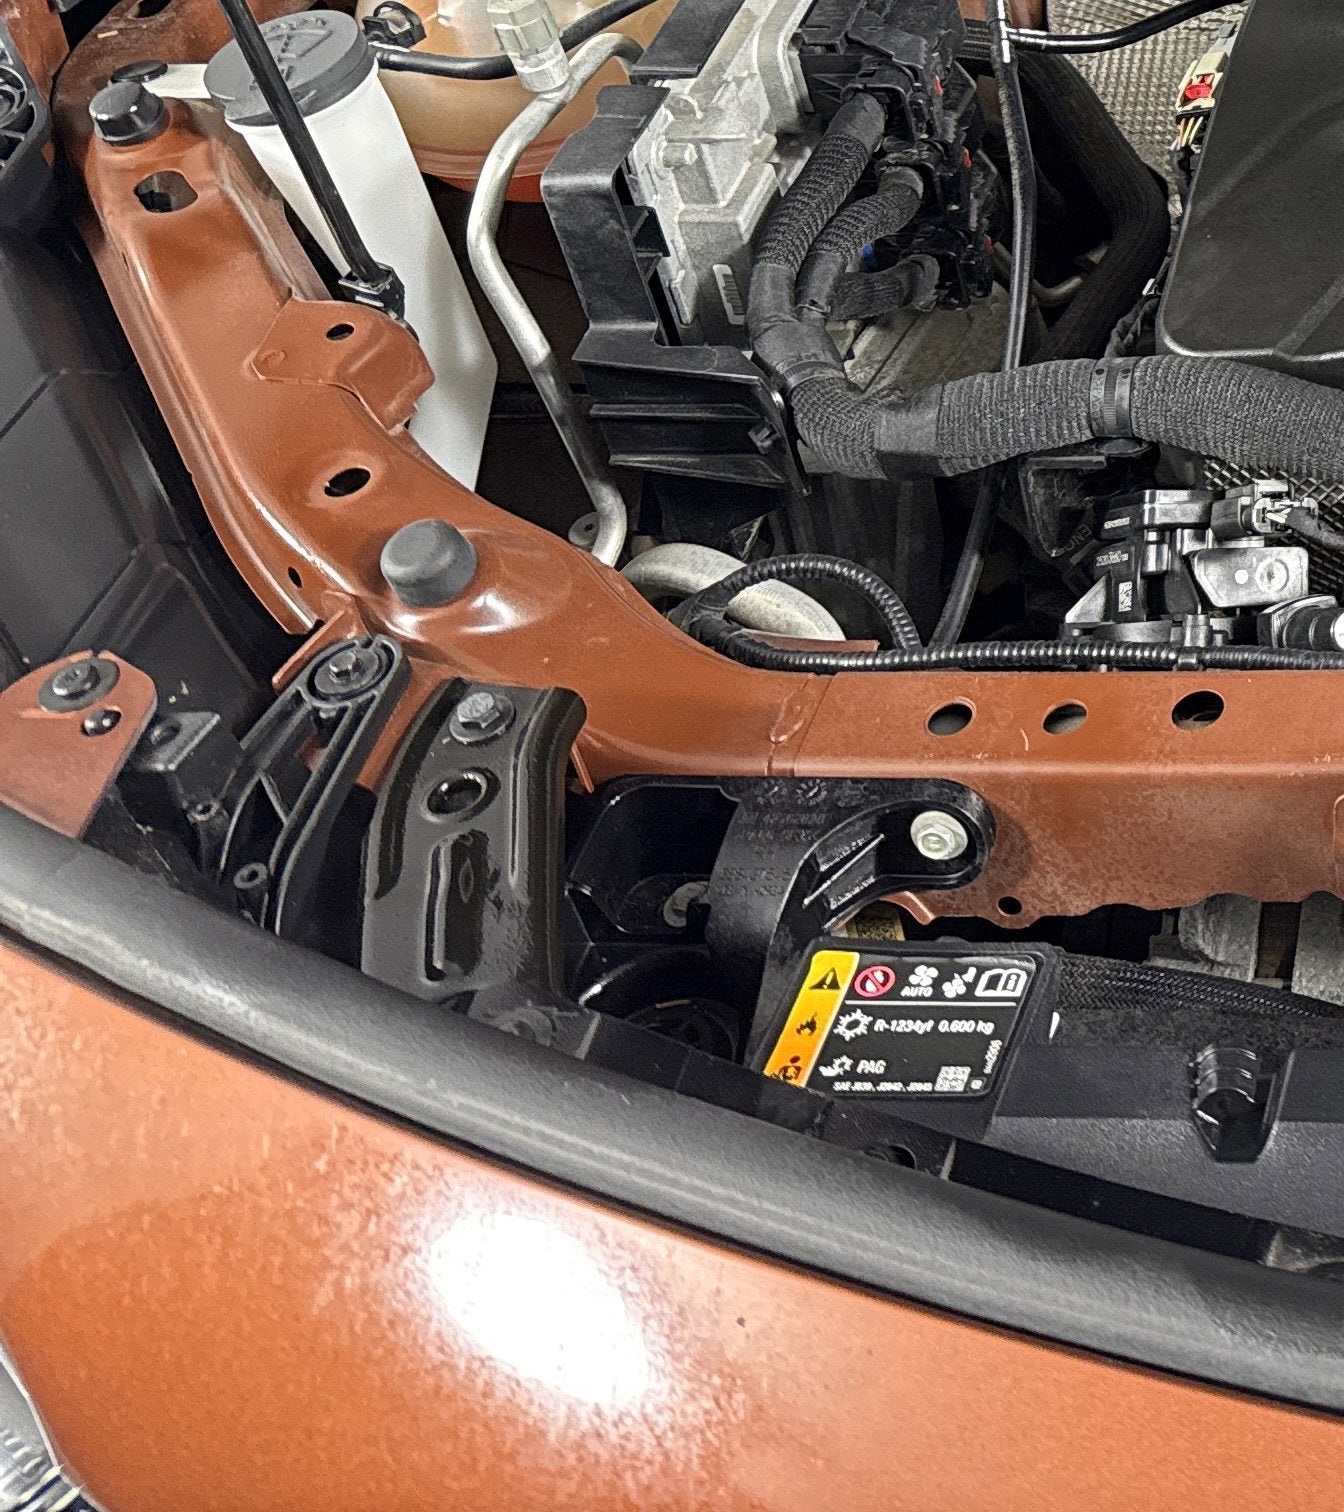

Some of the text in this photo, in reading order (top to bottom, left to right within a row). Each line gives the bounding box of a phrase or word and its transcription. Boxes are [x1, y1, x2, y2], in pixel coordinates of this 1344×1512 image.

[900, 985, 933, 998] AUTO
[873, 1018, 995, 1036] R-1234yf 0.600 kg
[855, 1059, 887, 1075] PAG
